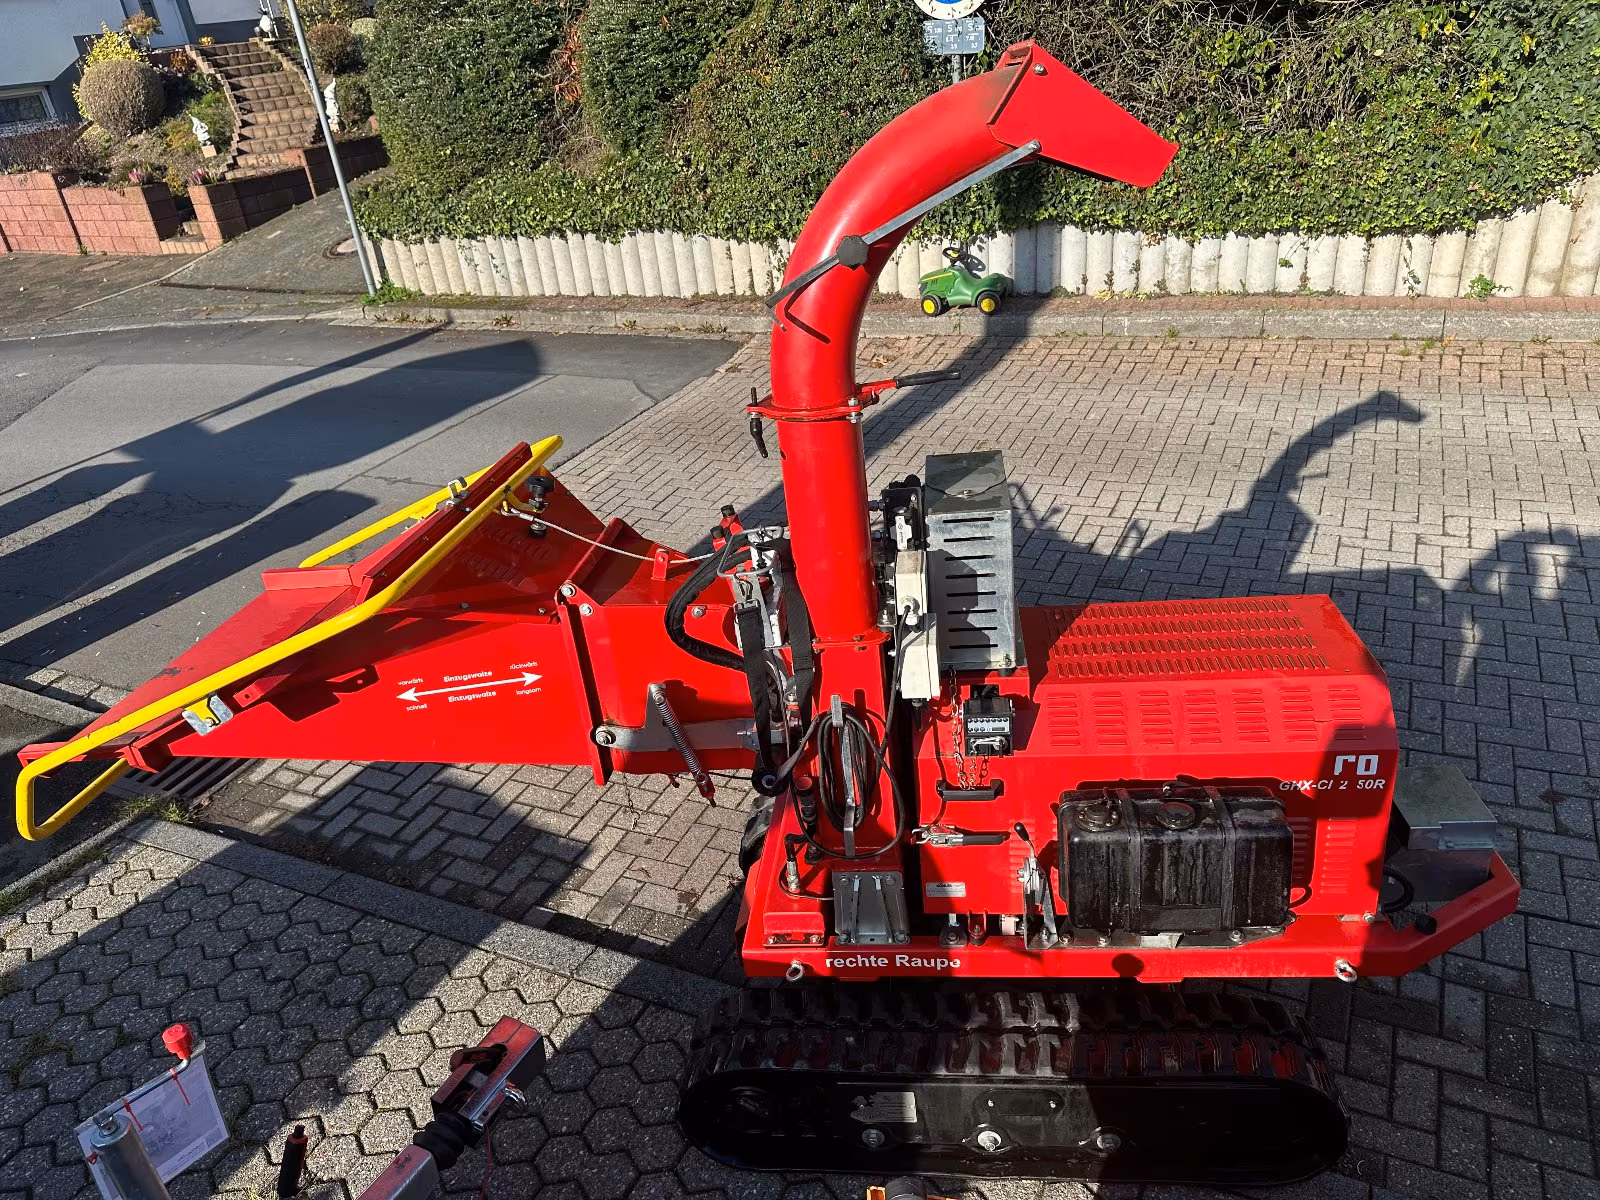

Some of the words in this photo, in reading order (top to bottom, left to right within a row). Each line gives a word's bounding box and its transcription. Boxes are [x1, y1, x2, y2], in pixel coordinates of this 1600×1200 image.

[509, 661, 538, 670] rückwärts
[443, 670, 493, 683] Einzugswalze
[397, 677, 423, 686] vorwärts
[516, 687, 542, 696] langsam
[448, 690, 497, 703] Einzugswalze
[405, 703, 428, 712] schnell
[825, 954, 889, 968] rechte
